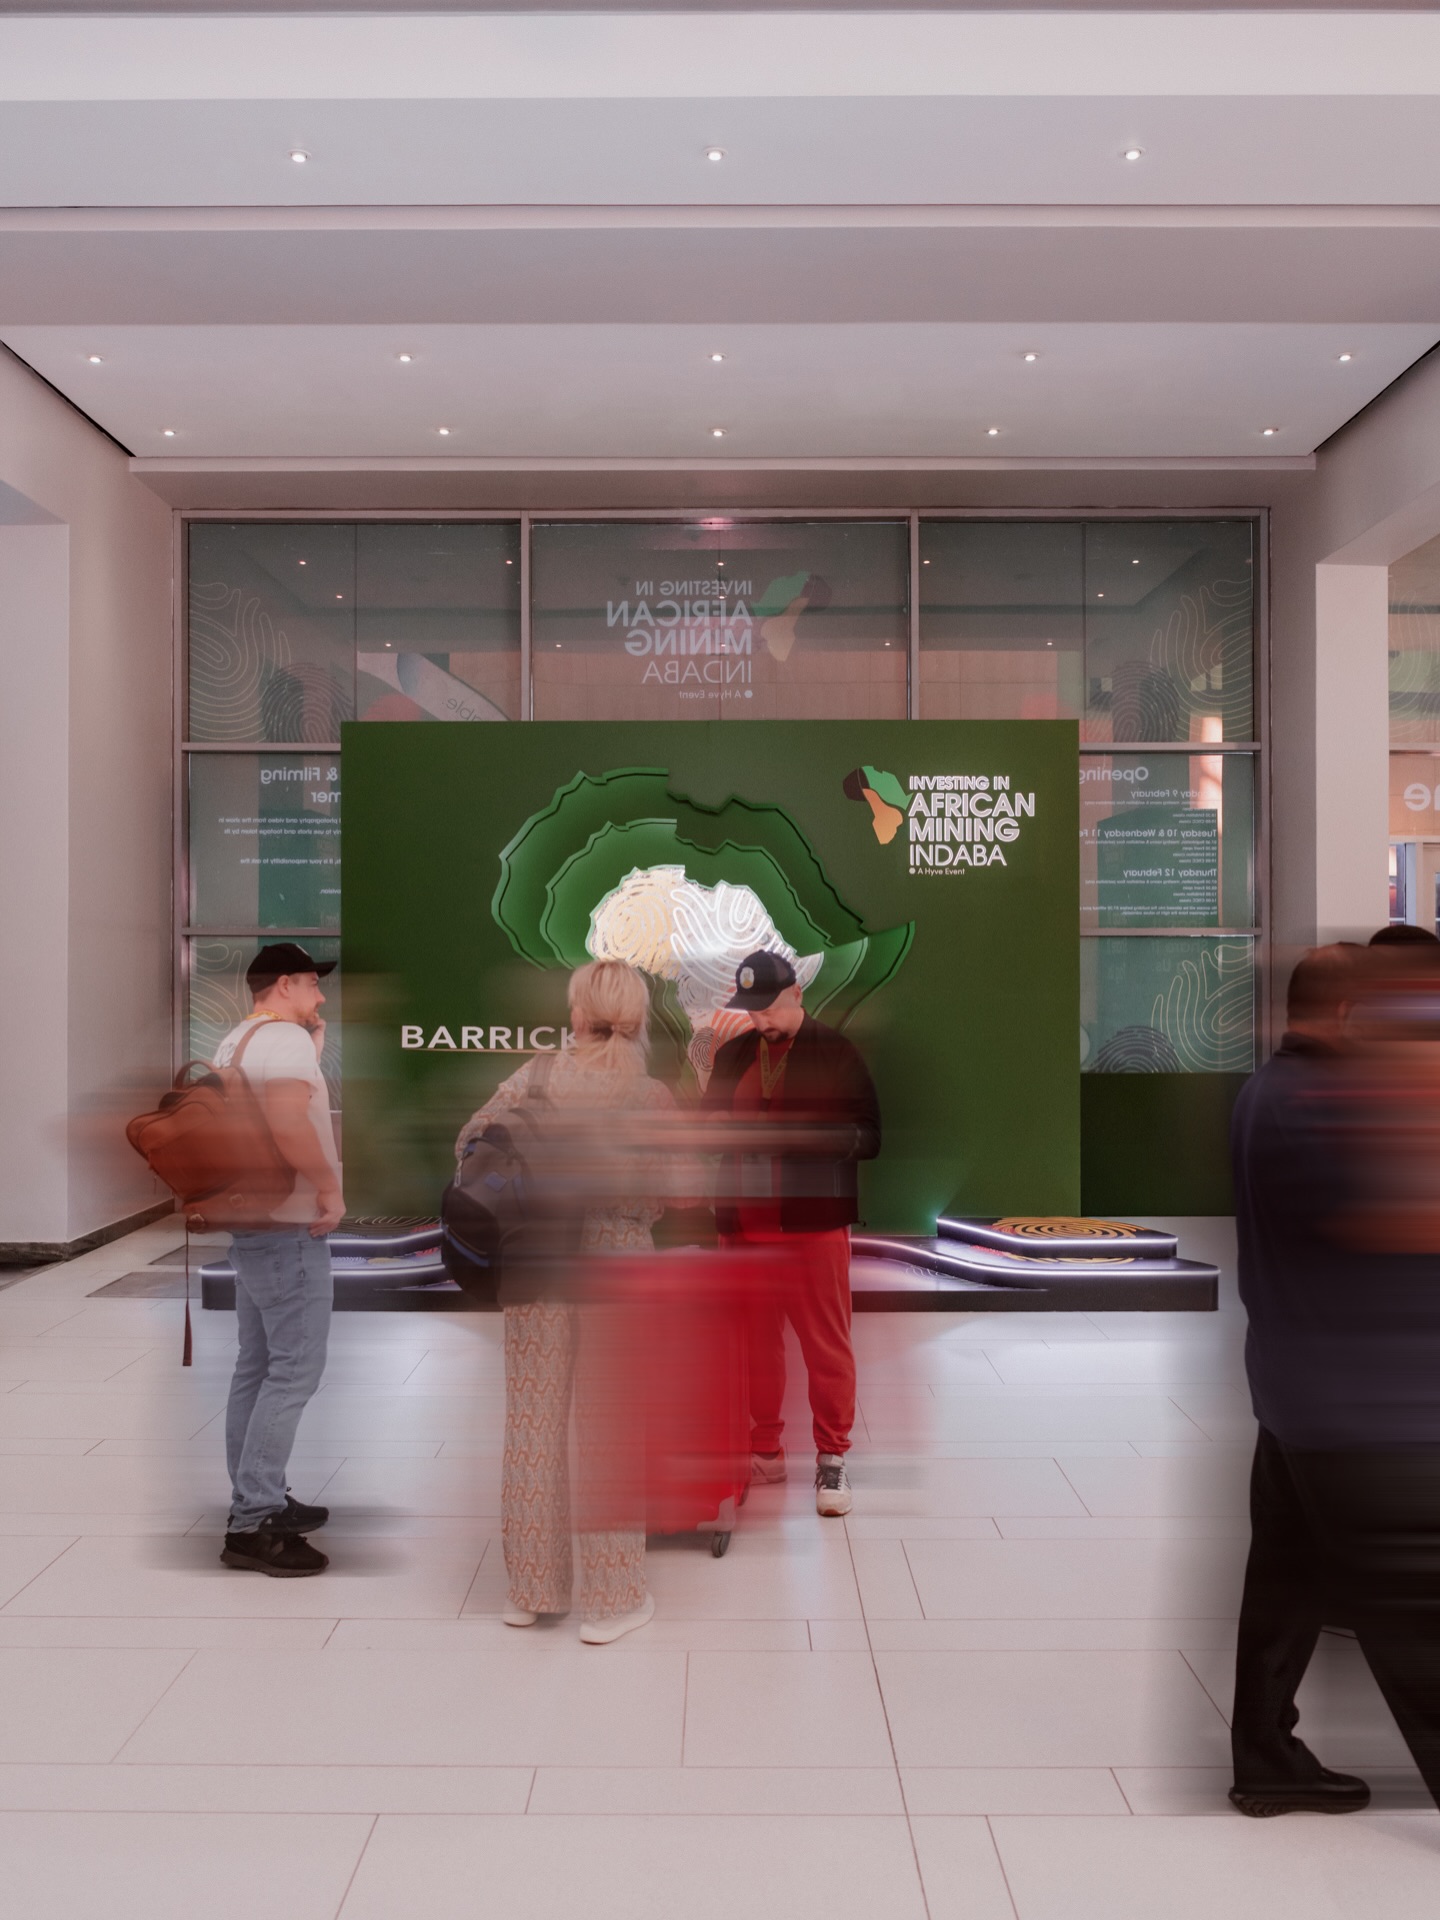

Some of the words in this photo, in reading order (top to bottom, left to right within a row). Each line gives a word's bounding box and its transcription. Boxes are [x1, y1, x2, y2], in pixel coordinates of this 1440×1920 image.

[909, 776, 990, 790] INVESTING
[993, 776, 1010, 790] IN
[908, 792, 1035, 818] AFRICAN
[909, 818, 1020, 842] MINING
[910, 844, 1008, 866] INDABA
[925, 868, 944, 877] Hyve
[401, 1025, 576, 1050] BARRICK
